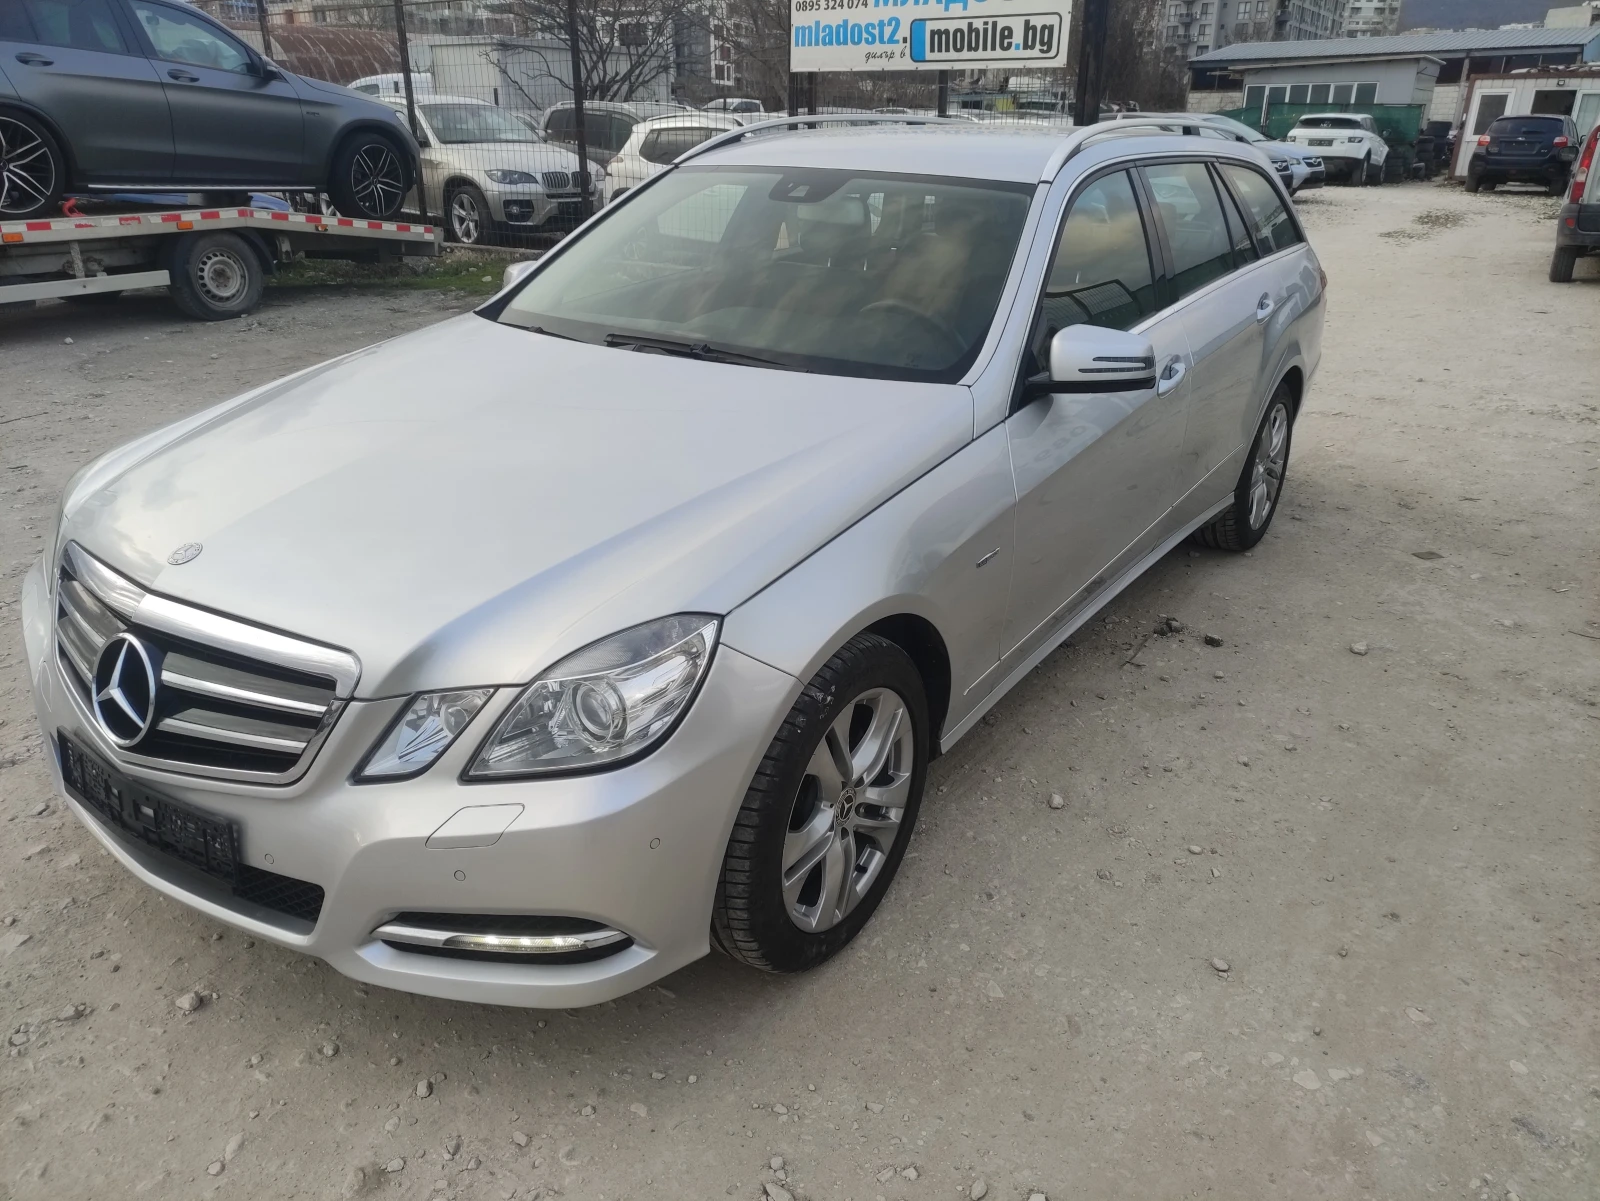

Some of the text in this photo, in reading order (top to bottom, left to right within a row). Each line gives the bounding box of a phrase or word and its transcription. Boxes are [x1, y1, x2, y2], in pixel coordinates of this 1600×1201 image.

[795, 0, 820, 12] 0895
[823, 0, 844, 11] 324
[847, 0, 869, 9] 074
[929, 19, 1055, 55] mobile.bg
